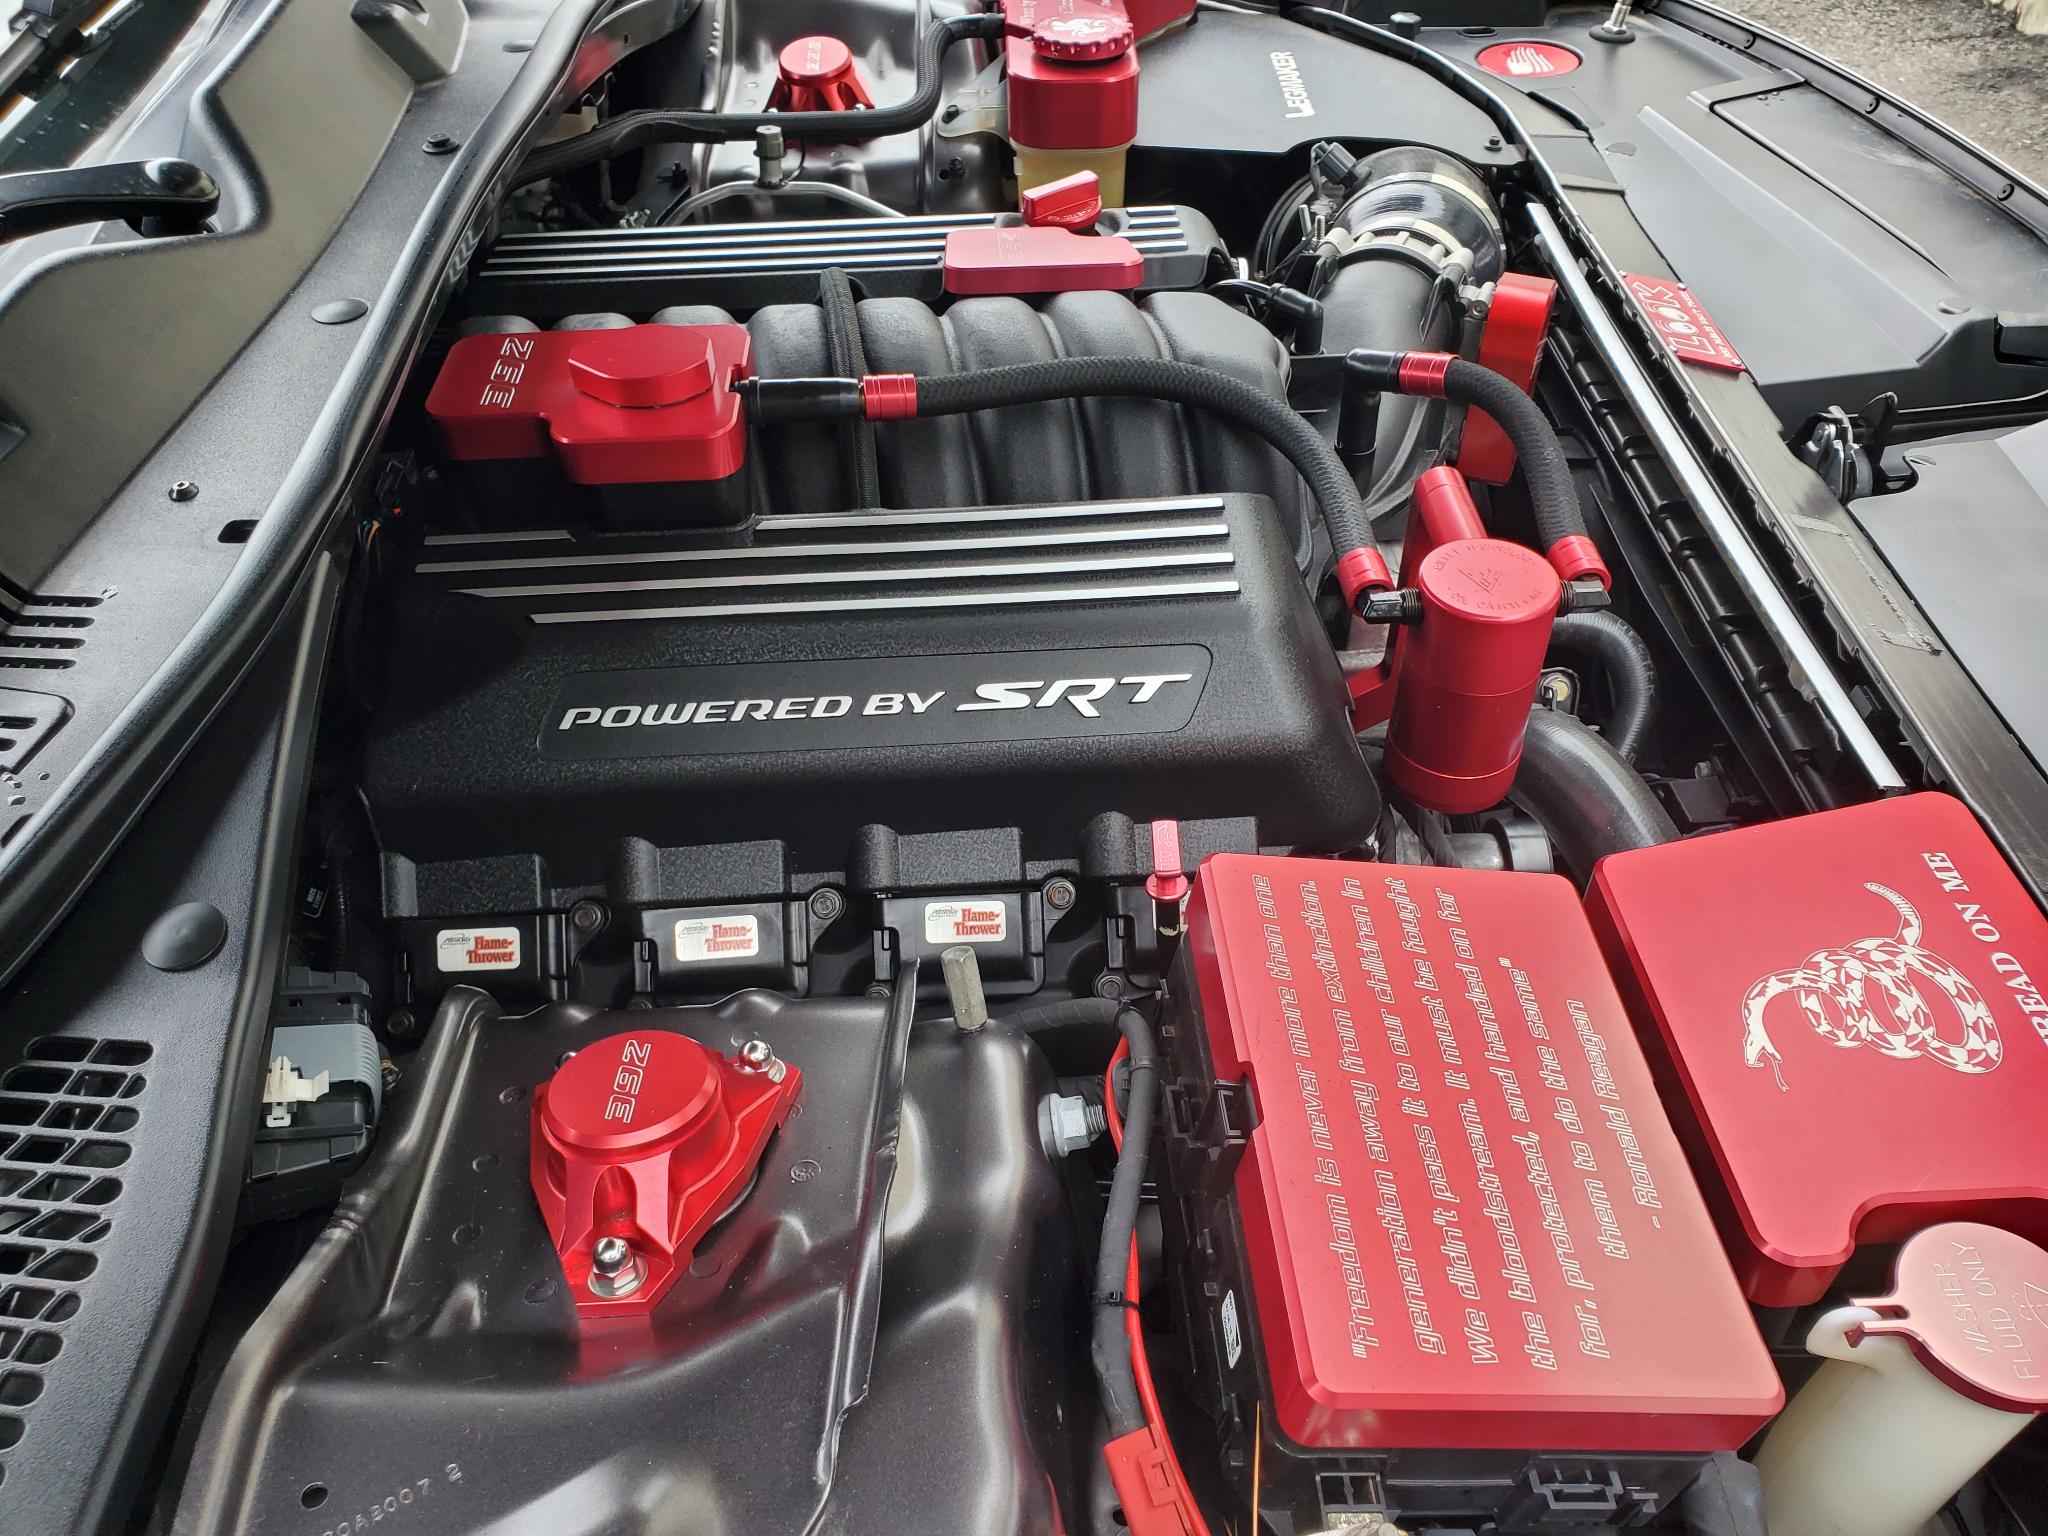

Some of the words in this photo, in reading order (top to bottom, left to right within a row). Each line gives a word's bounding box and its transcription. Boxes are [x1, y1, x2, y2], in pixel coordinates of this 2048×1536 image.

[1270, 51, 1316, 118] LEGMAKER
[480, 337, 534, 408] 392
[558, 695, 853, 730] POWERED
[861, 691, 946, 715] BY
[955, 673, 1193, 718] SRT
[1252, 874, 1277, 918] one
[1340, 877, 1365, 900] in
[1921, 852, 1970, 893] ME
[712, 924, 753, 938] Flame-
[954, 922, 1001, 936] Thrower
[961, 907, 1002, 921] Flame-
[1384, 877, 1427, 954] fought
[1435, 888, 1462, 922] for
[1954, 903, 2000, 942] ON
[466, 950, 514, 964] Thrower
[474, 935, 514, 949] Flame-
[704, 938, 753, 952] Thrower
[1264, 924, 1292, 981] than
[1300, 880, 1347, 1003] extinction.
[1351, 904, 1395, 1004] children
[1449, 927, 1475, 960] on
[1414, 959, 1439, 991] be
[1278, 986, 1311, 1058] more
[1380, 1008, 1410, 1057] our
[1421, 996, 1462, 1064] must
[1455, 962, 1511, 1063] handed
[1332, 1009, 1366, 1074] from
[1536, 1045, 1568, 1091] the
[1566, 999, 1620, 1100] Reagan
[605, 1040, 651, 1123] 392
[1396, 1062, 1420, 1091] to
[1443, 1070, 1470, 1090] It
[1489, 1066, 1530, 1122] and
[1296, 1062, 1333, 1150] never
[1351, 1079, 1388, 1162] away
[1401, 1097, 1428, 1118] it
[1553, 1096, 1584, 1134] do
[1315, 1157, 1342, 1187] is
[1414, 1123, 1460, 1203] pass
[1570, 1140, 1597, 1171] to
[1600, 1104, 1662, 1209] Ronald
[1458, 1098, 1537, 1303] bloodstream.
[1511, 1131, 1595, 1290] protected,
[1583, 1178, 1630, 1260] them
[1374, 1169, 1447, 1355] generation
[1432, 1207, 1480, 1299] didn't
[1951, 1241, 1998, 1296] ONLY
[1464, 1308, 1499, 1364] We
[1574, 1299, 1612, 1359] for,
[1930, 1263, 1994, 1358] WASHER
[1521, 1311, 1558, 1371] the
[1986, 1307, 2041, 1379] FLUID
